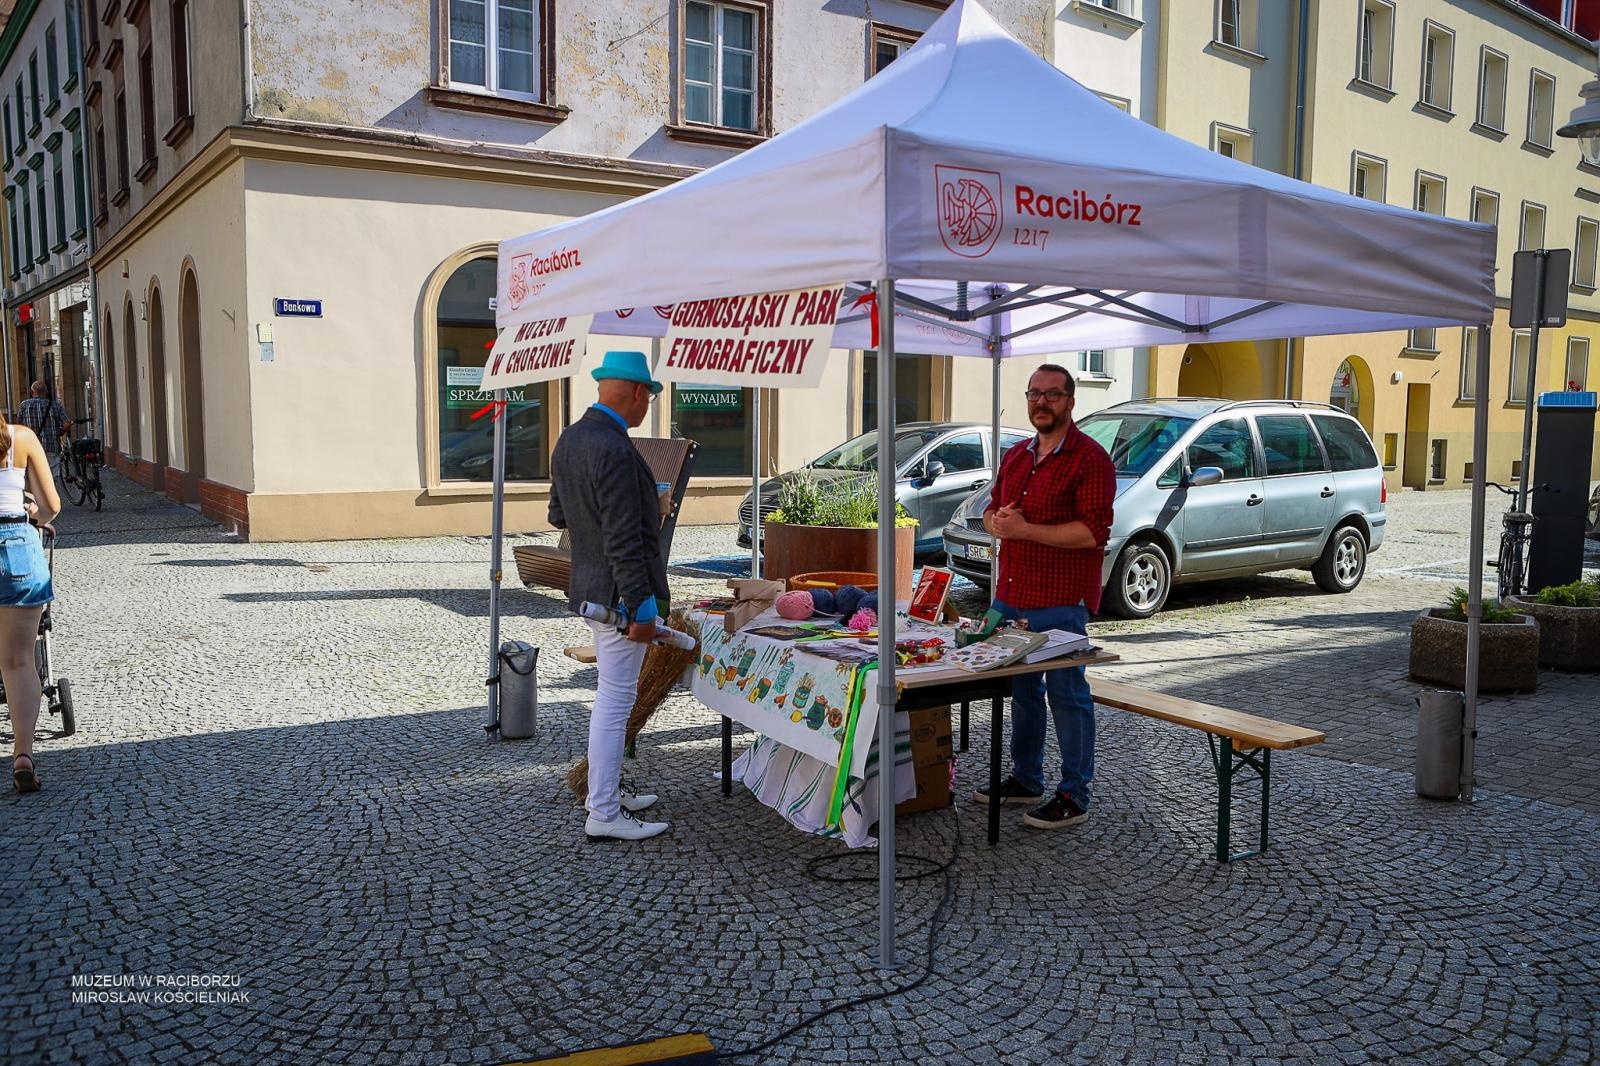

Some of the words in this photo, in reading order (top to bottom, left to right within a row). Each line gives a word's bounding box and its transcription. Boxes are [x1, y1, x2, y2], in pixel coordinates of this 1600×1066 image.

[1015, 185, 1142, 226] Racibórz
[1013, 228, 1049, 251] 1217
[530, 247, 581, 277] Racibórz
[283, 300, 316, 313] Bankowa
[791, 288, 843, 326] PARK
[514, 317, 567, 343] MUZEUM
[491, 353, 505, 377] W
[506, 339, 576, 374] CHORZOWIE
[666, 338, 814, 374] ETNOGRAFICZNY
[450, 389, 525, 401] SPRZEAM
[681, 393, 737, 406] WYNAJMĘ
